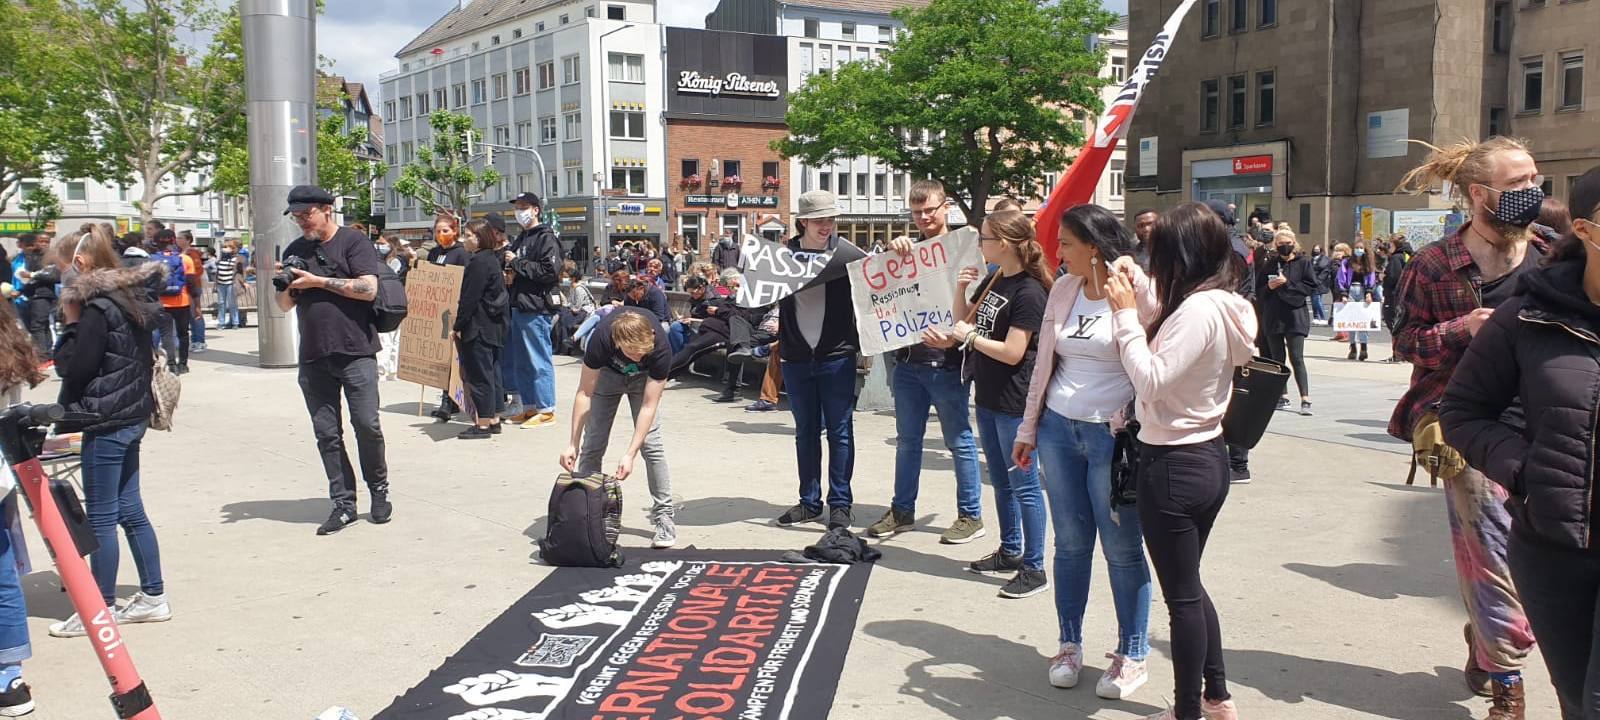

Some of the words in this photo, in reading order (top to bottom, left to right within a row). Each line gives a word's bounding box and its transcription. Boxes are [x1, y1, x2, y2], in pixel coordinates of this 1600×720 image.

[677, 71, 779, 97] König-Pilsener
[862, 241, 947, 291] Gegen
[789, 608, 810, 626] UND
[768, 624, 805, 660] FREIHEIT
[576, 665, 620, 705] VEREINT
[608, 636, 648, 665] GEGEN
[757, 658, 784, 679] FÜR
